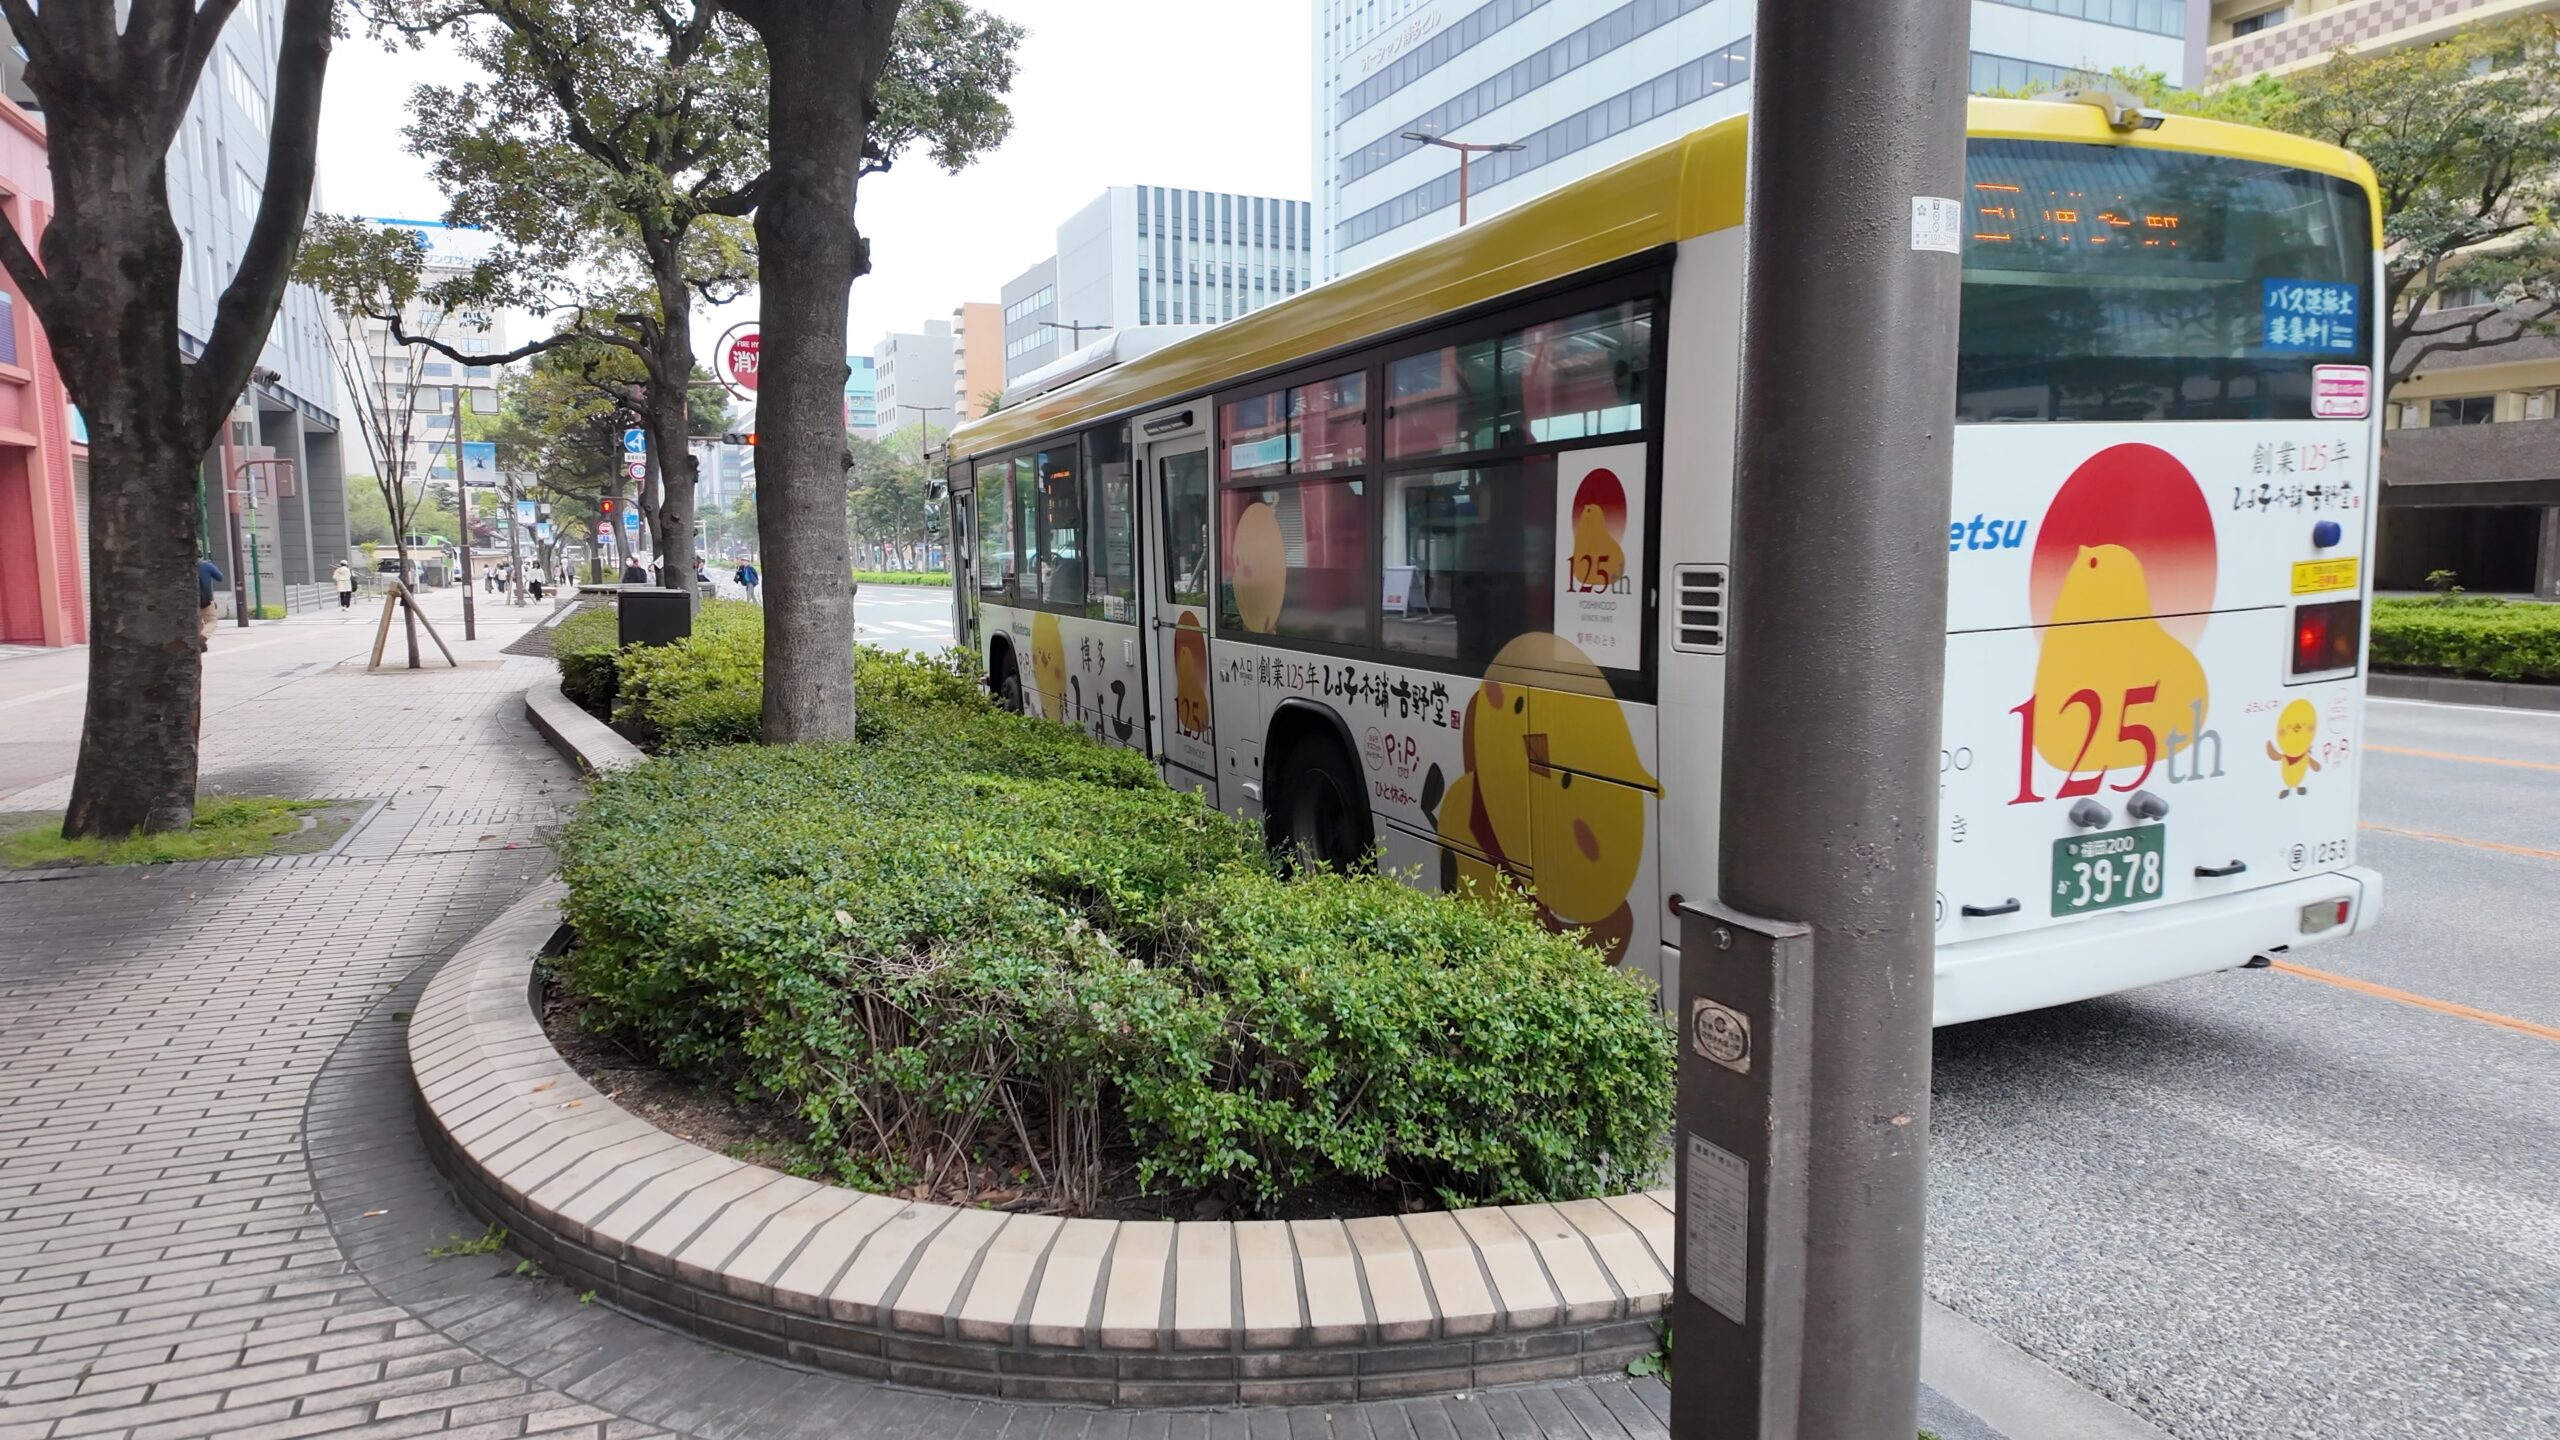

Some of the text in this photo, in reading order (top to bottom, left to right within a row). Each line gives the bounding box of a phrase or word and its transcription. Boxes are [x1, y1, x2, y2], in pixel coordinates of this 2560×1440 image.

[737, 340, 750, 348] FIRE
[2252, 440, 2351, 475] 創業125年
[1948, 513, 2027, 551] etsu
[1566, 554, 1632, 594] 125th
[1080, 637, 1106, 677] 博多
[1239, 656, 1253, 672] 入口
[1258, 655, 1320, 696] 創業125年
[2007, 680, 2226, 806] 125th
[2311, 839, 2348, 865] 1253
[2071, 850, 2161, 907] 39-78
